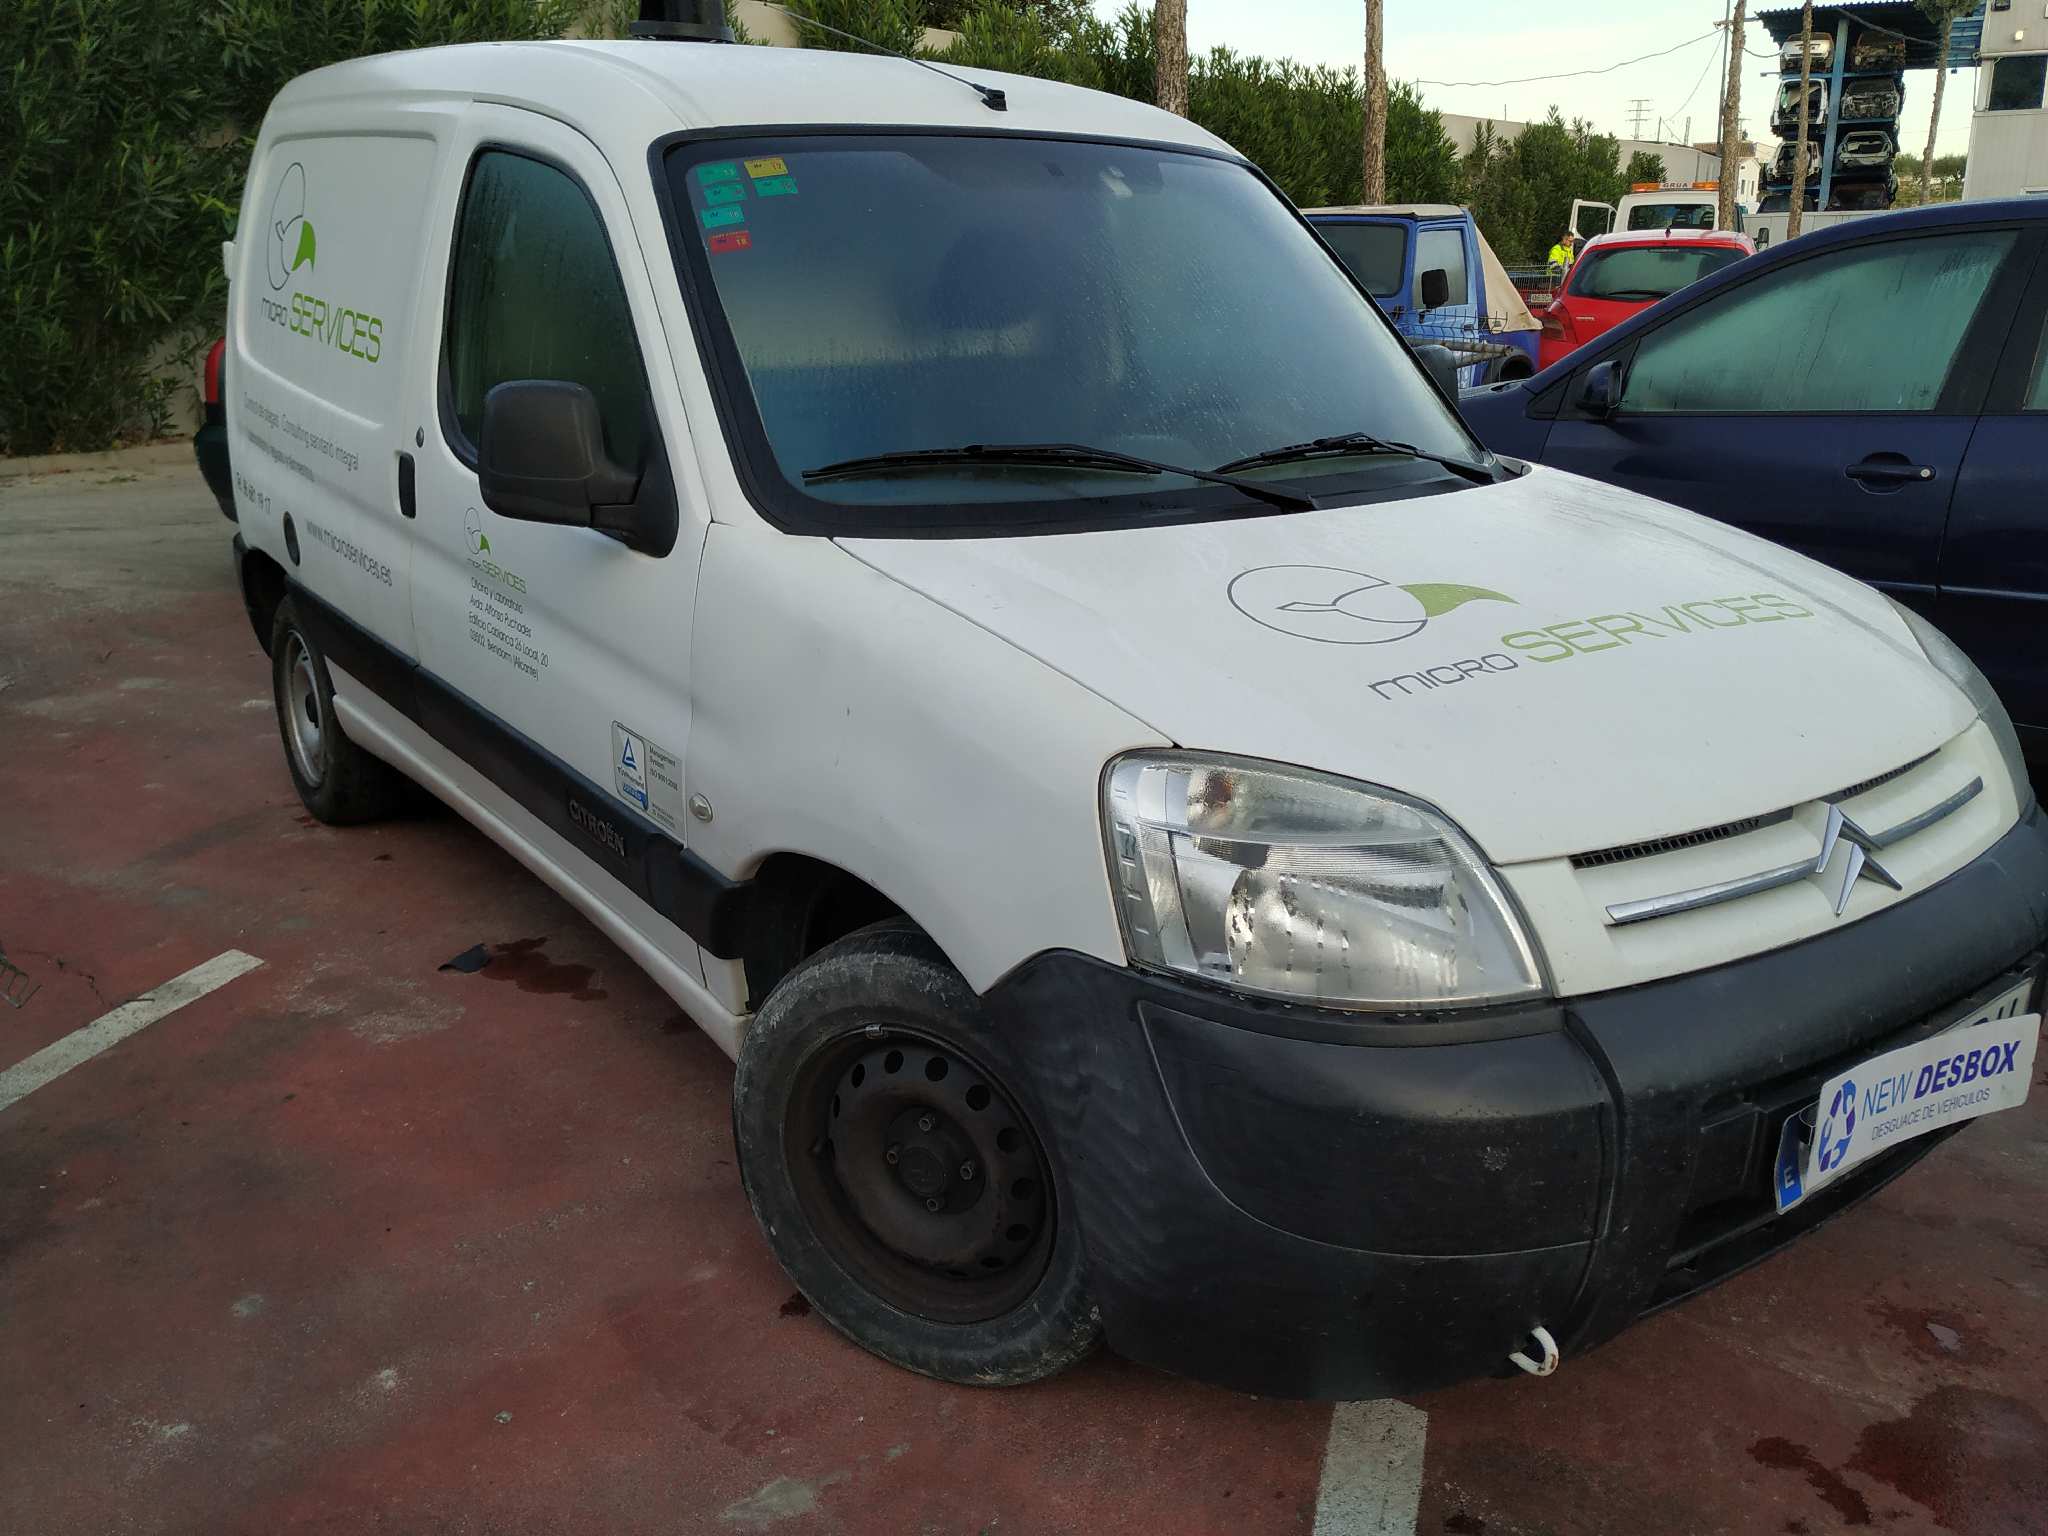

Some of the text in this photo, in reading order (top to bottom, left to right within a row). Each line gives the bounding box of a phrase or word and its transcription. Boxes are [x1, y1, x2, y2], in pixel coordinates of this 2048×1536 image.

[289, 291, 383, 363] SERVICES
[482, 559, 527, 594] SERVICES
[1501, 593, 1815, 663] SERVICES
[569, 800, 625, 857] CITROËN
[1860, 1040, 2021, 1120] NEW DESBOX
[1872, 1107, 1921, 1140] DESGUACE
[1922, 1103, 1936, 1120] DE
[1784, 1167, 1793, 1188] E
